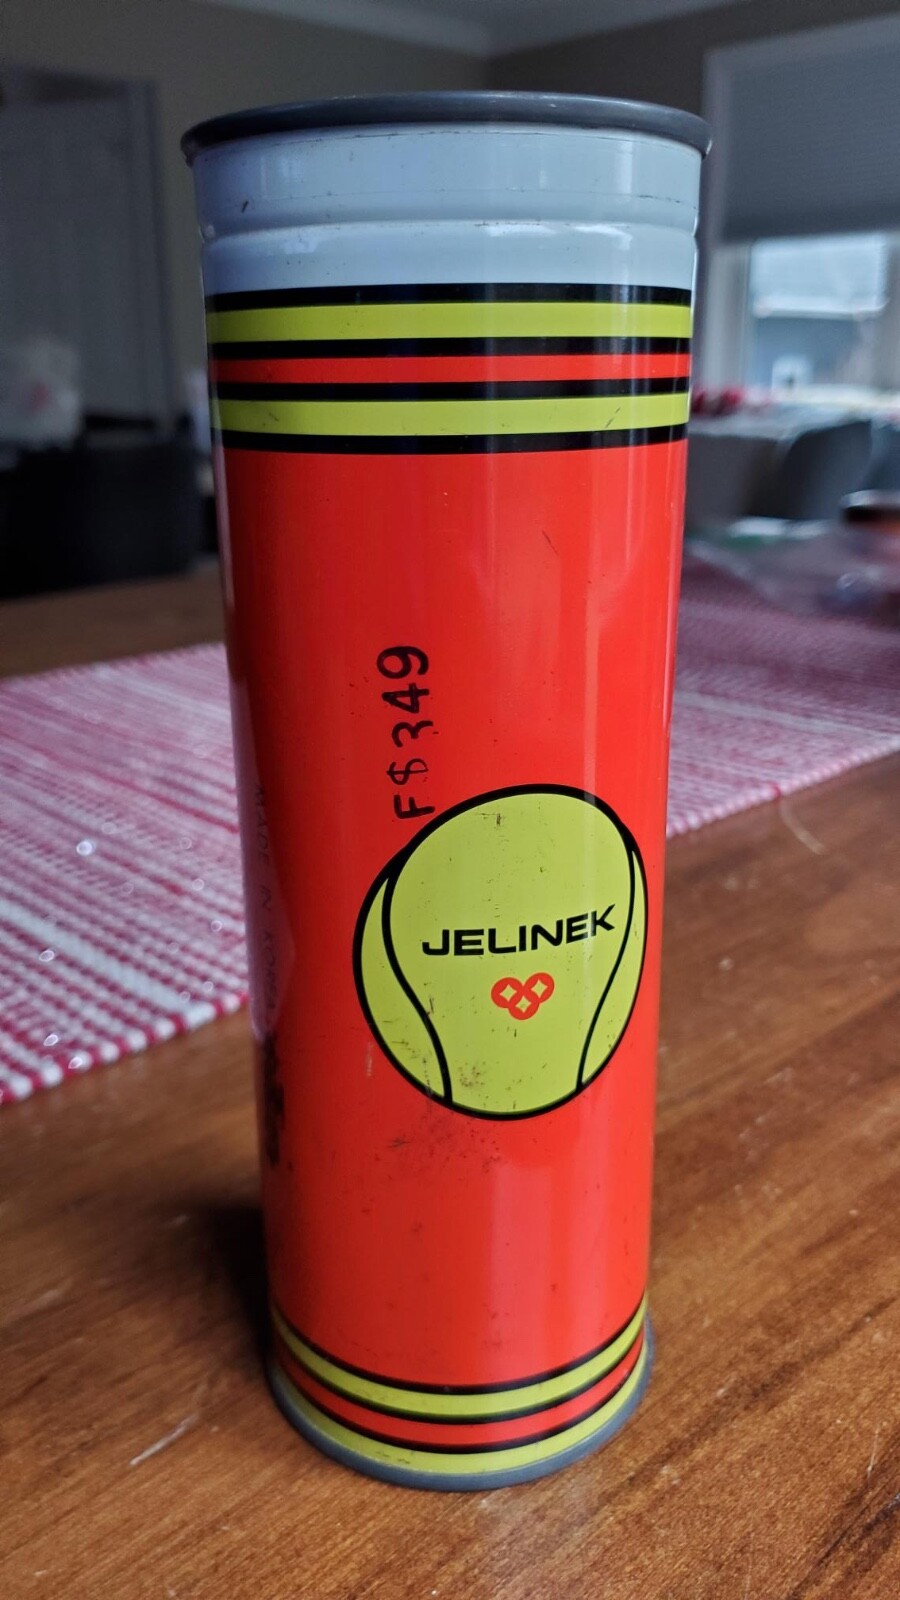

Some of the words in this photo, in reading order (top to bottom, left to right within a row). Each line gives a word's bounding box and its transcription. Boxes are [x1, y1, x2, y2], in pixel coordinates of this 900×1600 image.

[255, 784, 270, 867] MADE
[260, 885, 273, 911] IN
[422, 904, 615, 956] JELINEK
